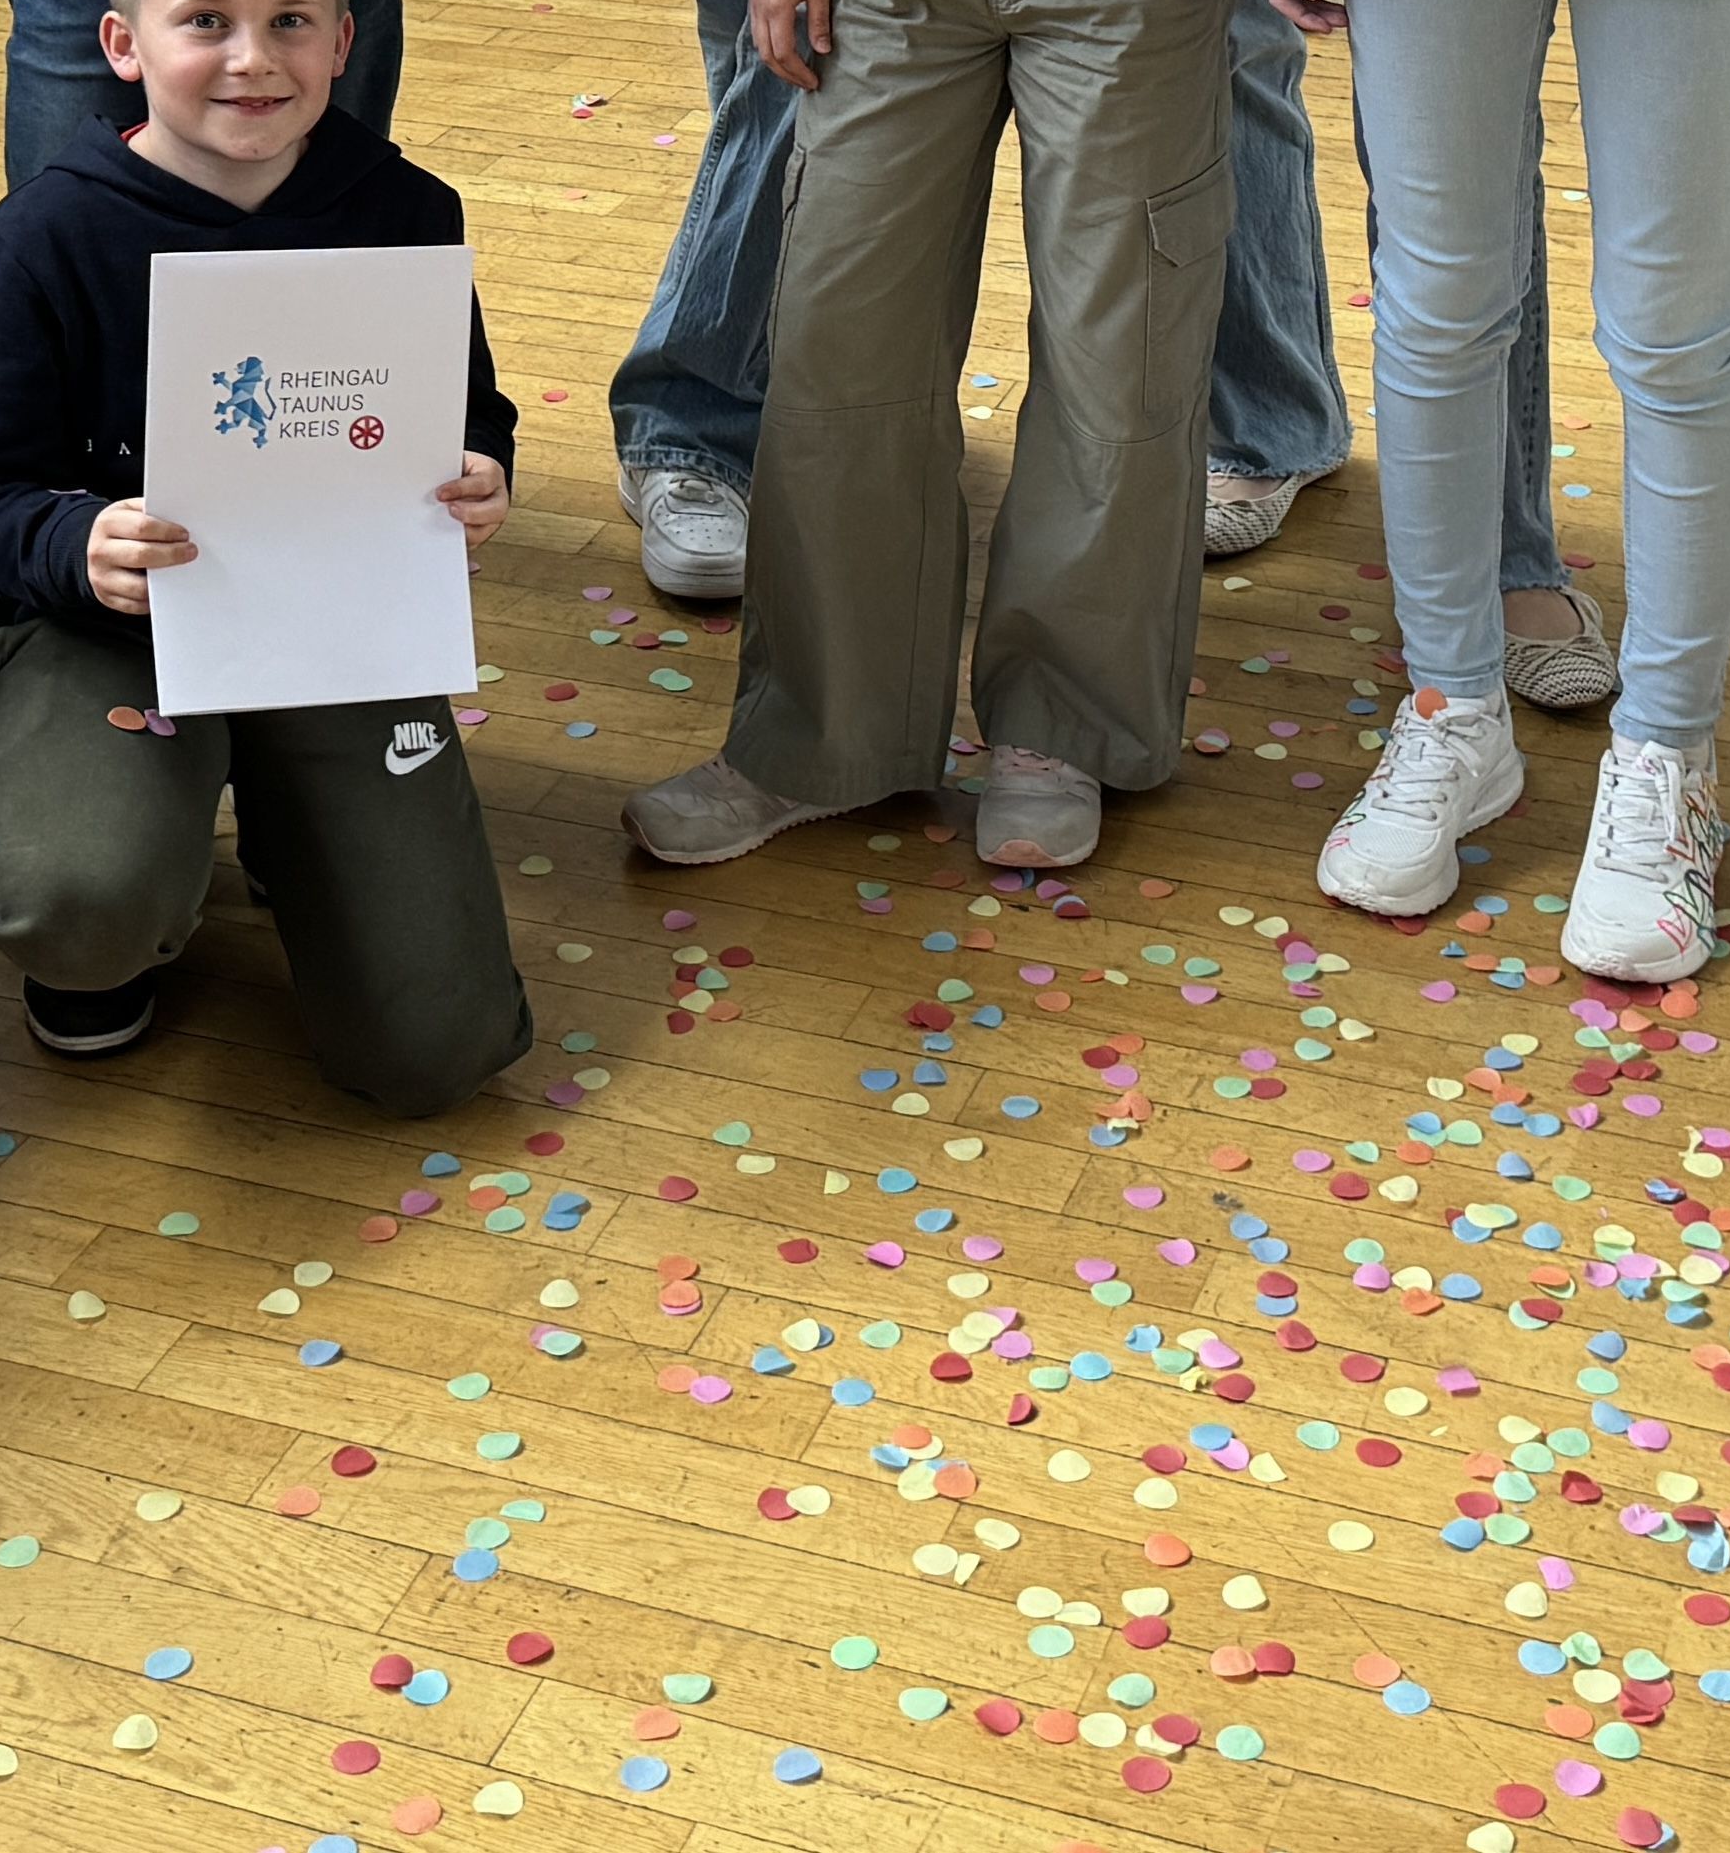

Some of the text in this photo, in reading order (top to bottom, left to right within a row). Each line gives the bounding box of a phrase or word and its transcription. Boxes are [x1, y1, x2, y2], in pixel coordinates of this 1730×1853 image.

[279, 368, 390, 390] RHEINGAU
[278, 393, 365, 415] TAUNUS
[278, 419, 341, 439] KREIS
[393, 721, 440, 752] NIKE
